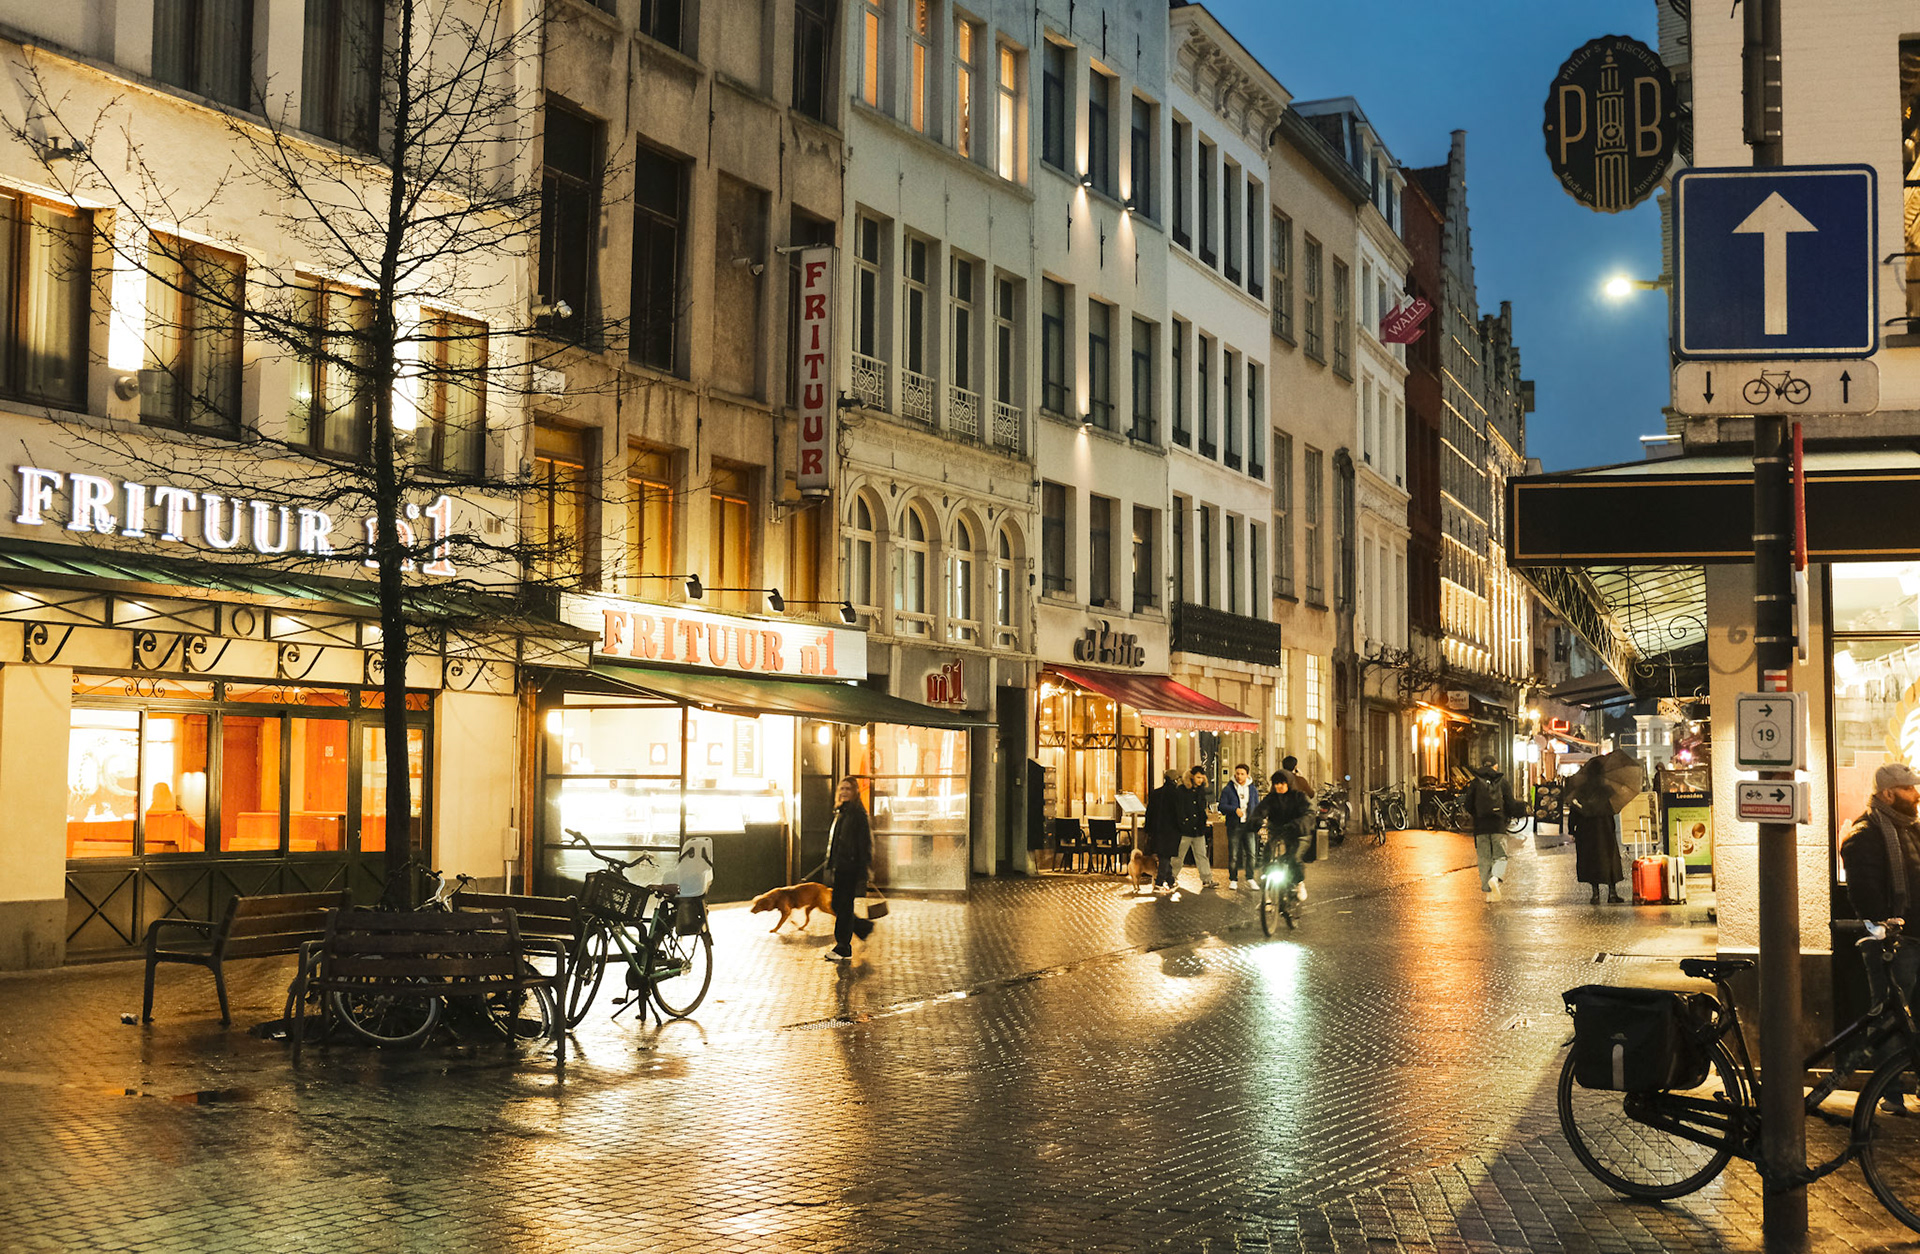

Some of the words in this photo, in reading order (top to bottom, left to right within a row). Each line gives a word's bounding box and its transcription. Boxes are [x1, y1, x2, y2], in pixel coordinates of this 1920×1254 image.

[1562, 45, 1602, 80] PHILIPS
[1615, 42, 1659, 73] BISCUITS
[1559, 85, 1587, 165] P
[1634, 76, 1663, 158] B
[1561, 172, 1583, 196] Made
[1583, 191, 1594, 201] in
[1633, 158, 1665, 195] Antwerp
[1388, 299, 1427, 336] WALLS
[801, 261, 827, 475] FRITUUR
[14, 465, 335, 560] FRITUUR
[602, 609, 785, 672] FRITUUR
[1757, 728, 1775, 742] 19
